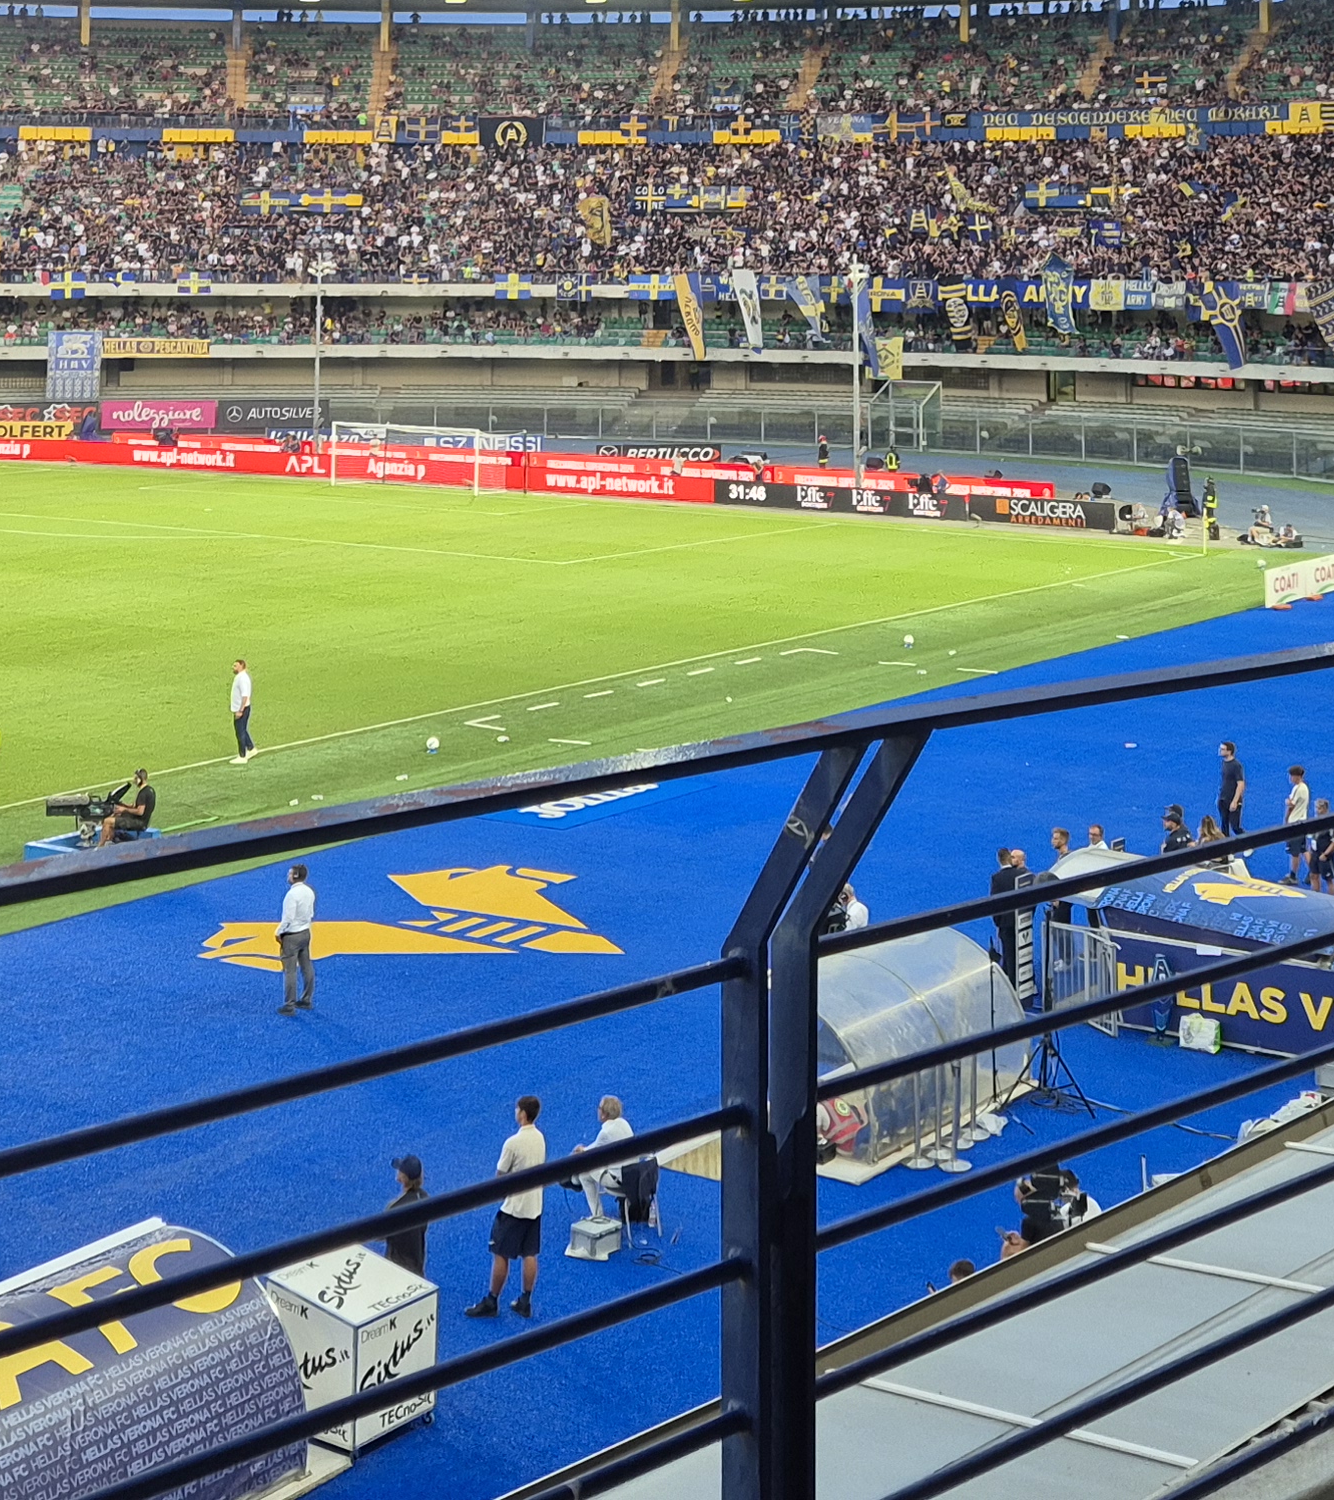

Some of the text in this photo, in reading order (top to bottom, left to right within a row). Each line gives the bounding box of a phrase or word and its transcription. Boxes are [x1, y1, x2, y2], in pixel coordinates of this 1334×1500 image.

[153, 341, 208, 355] PESCANTINA
[112, 401, 202, 429] noleggiare
[22, 442, 31, 458] p
[132, 449, 236, 468] www.apl-network.it
[285, 456, 326, 474] APL
[367, 458, 415, 478] Agenzia
[417, 463, 426, 480] p
[545, 473, 675, 495] www.apl-network.it
[728, 483, 767, 501] 31:46
[796, 485, 825, 503] Effe
[851, 488, 881, 507] Effe
[907, 493, 937, 511] Effe
[1009, 499, 1087, 519] SCALIGERA
[1010, 514, 1086, 528] ARREDAMENTI
[1273, 572, 1299, 594] COATI
[1117, 962, 1288, 1024] HLLAS
[4, 1399, 42, 1430] HELLAS
[45, 1378, 87, 1410] VERONA
[89, 1372, 101, 1388] FC
[105, 1353, 141, 1382] HELLAS
[144, 1334, 182, 1363] VERONA
[184, 1327, 196, 1343] FC
[199, 1309, 232, 1337] HELLAS
[26, 1405, 68, 1437] VERONA
[127, 1358, 165, 1388] VERONA
[168, 1351, 180, 1367] FC
[183, 1333, 217, 1361] HELLAS
[219, 1315, 254, 1344] VERONA
[38, 1432, 51, 1450] FC
[95, 1390, 136, 1422] VERONA
[138, 1383, 151, 1400] FC
[155, 1365, 189, 1393] HELLAS
[191, 1345, 228, 1375] VERONA
[230, 1339, 243, 1355] FC
[13, 1347, 259, 1480] FC VERONA FC HELLAS VERONA FC HELLAS
[81, 1361, 266, 1465] HELLAS VERONA FC HELLAS VERONA FC
[72, 1381, 259, 1488] VERONA FC HELLAS VERONA FC HELLAS
[126, 1380, 292, 1477] HELLAS VERONA FC HELLAS VERONA
